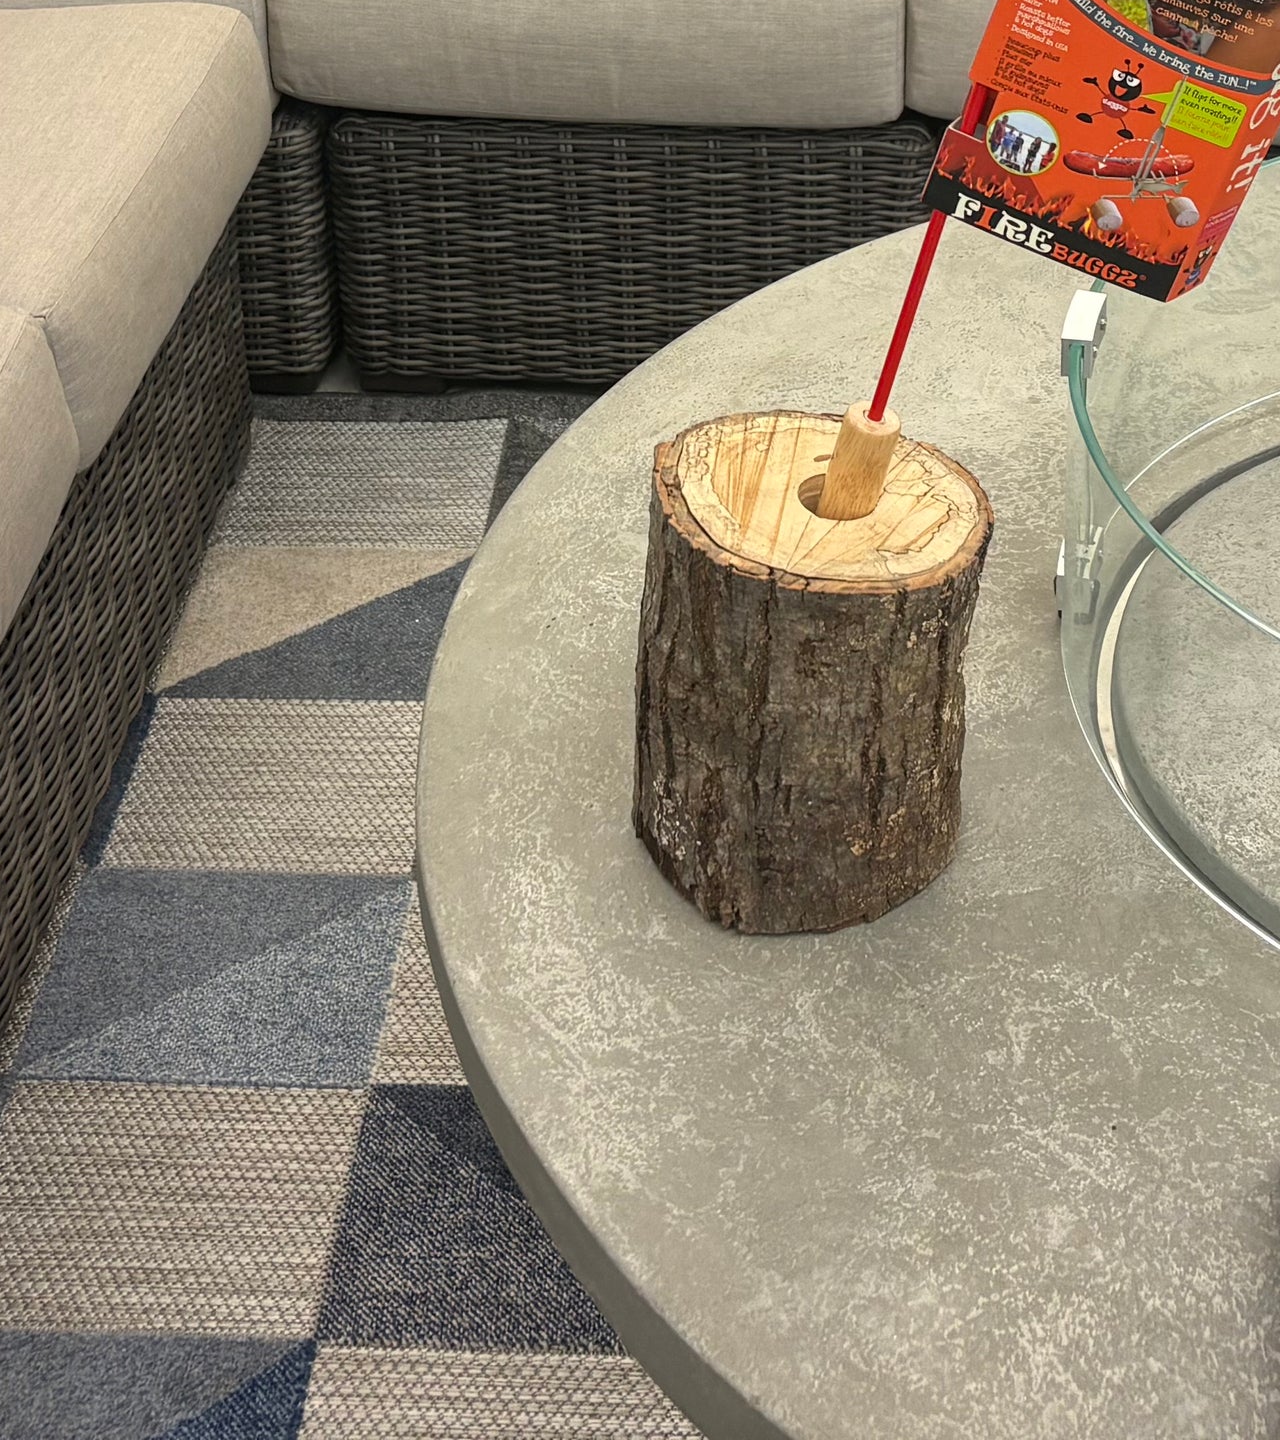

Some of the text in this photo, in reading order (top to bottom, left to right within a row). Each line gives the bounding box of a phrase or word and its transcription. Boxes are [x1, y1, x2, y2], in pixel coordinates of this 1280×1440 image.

[1211, 13, 1231, 27] sur
[1234, 22, 1255, 36] une
[1244, 10, 1253, 20] &
[1255, 13, 1275, 27] les
[1093, 9, 1114, 29] the
[1142, 42, 1157, 57] We
[1158, 49, 1192, 76] bring
[1194, 66, 1215, 82] the
[1180, 98, 1201, 110] even
[1191, 87, 1209, 104] flips
[1208, 93, 1222, 108] for
